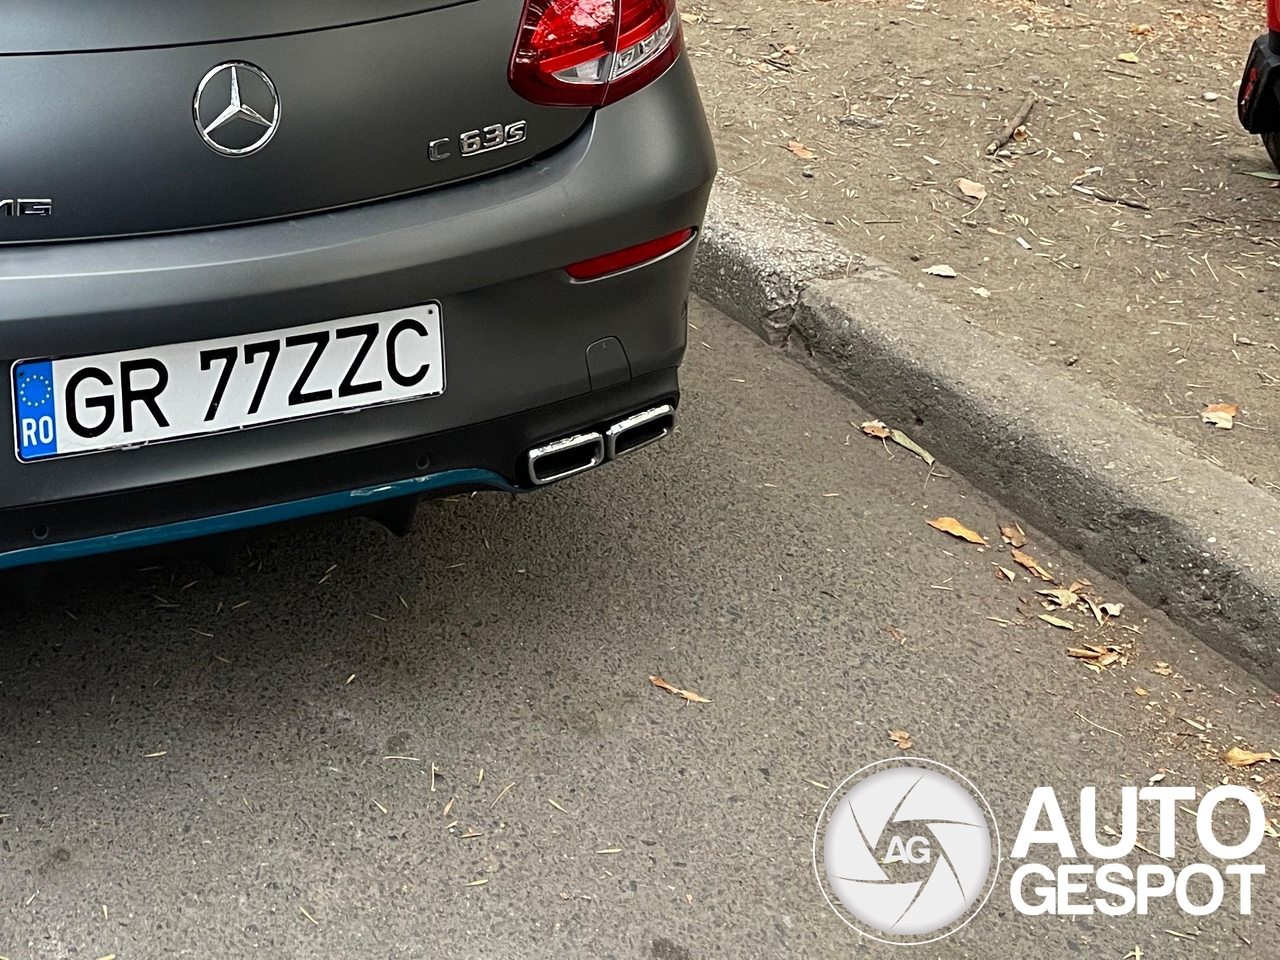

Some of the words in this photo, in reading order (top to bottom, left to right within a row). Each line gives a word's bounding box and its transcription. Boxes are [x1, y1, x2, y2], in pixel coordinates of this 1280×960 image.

[428, 137, 451, 161] C
[64, 357, 170, 439] GR
[199, 318, 431, 422] 77ZZC
[22, 415, 54, 447] RO
